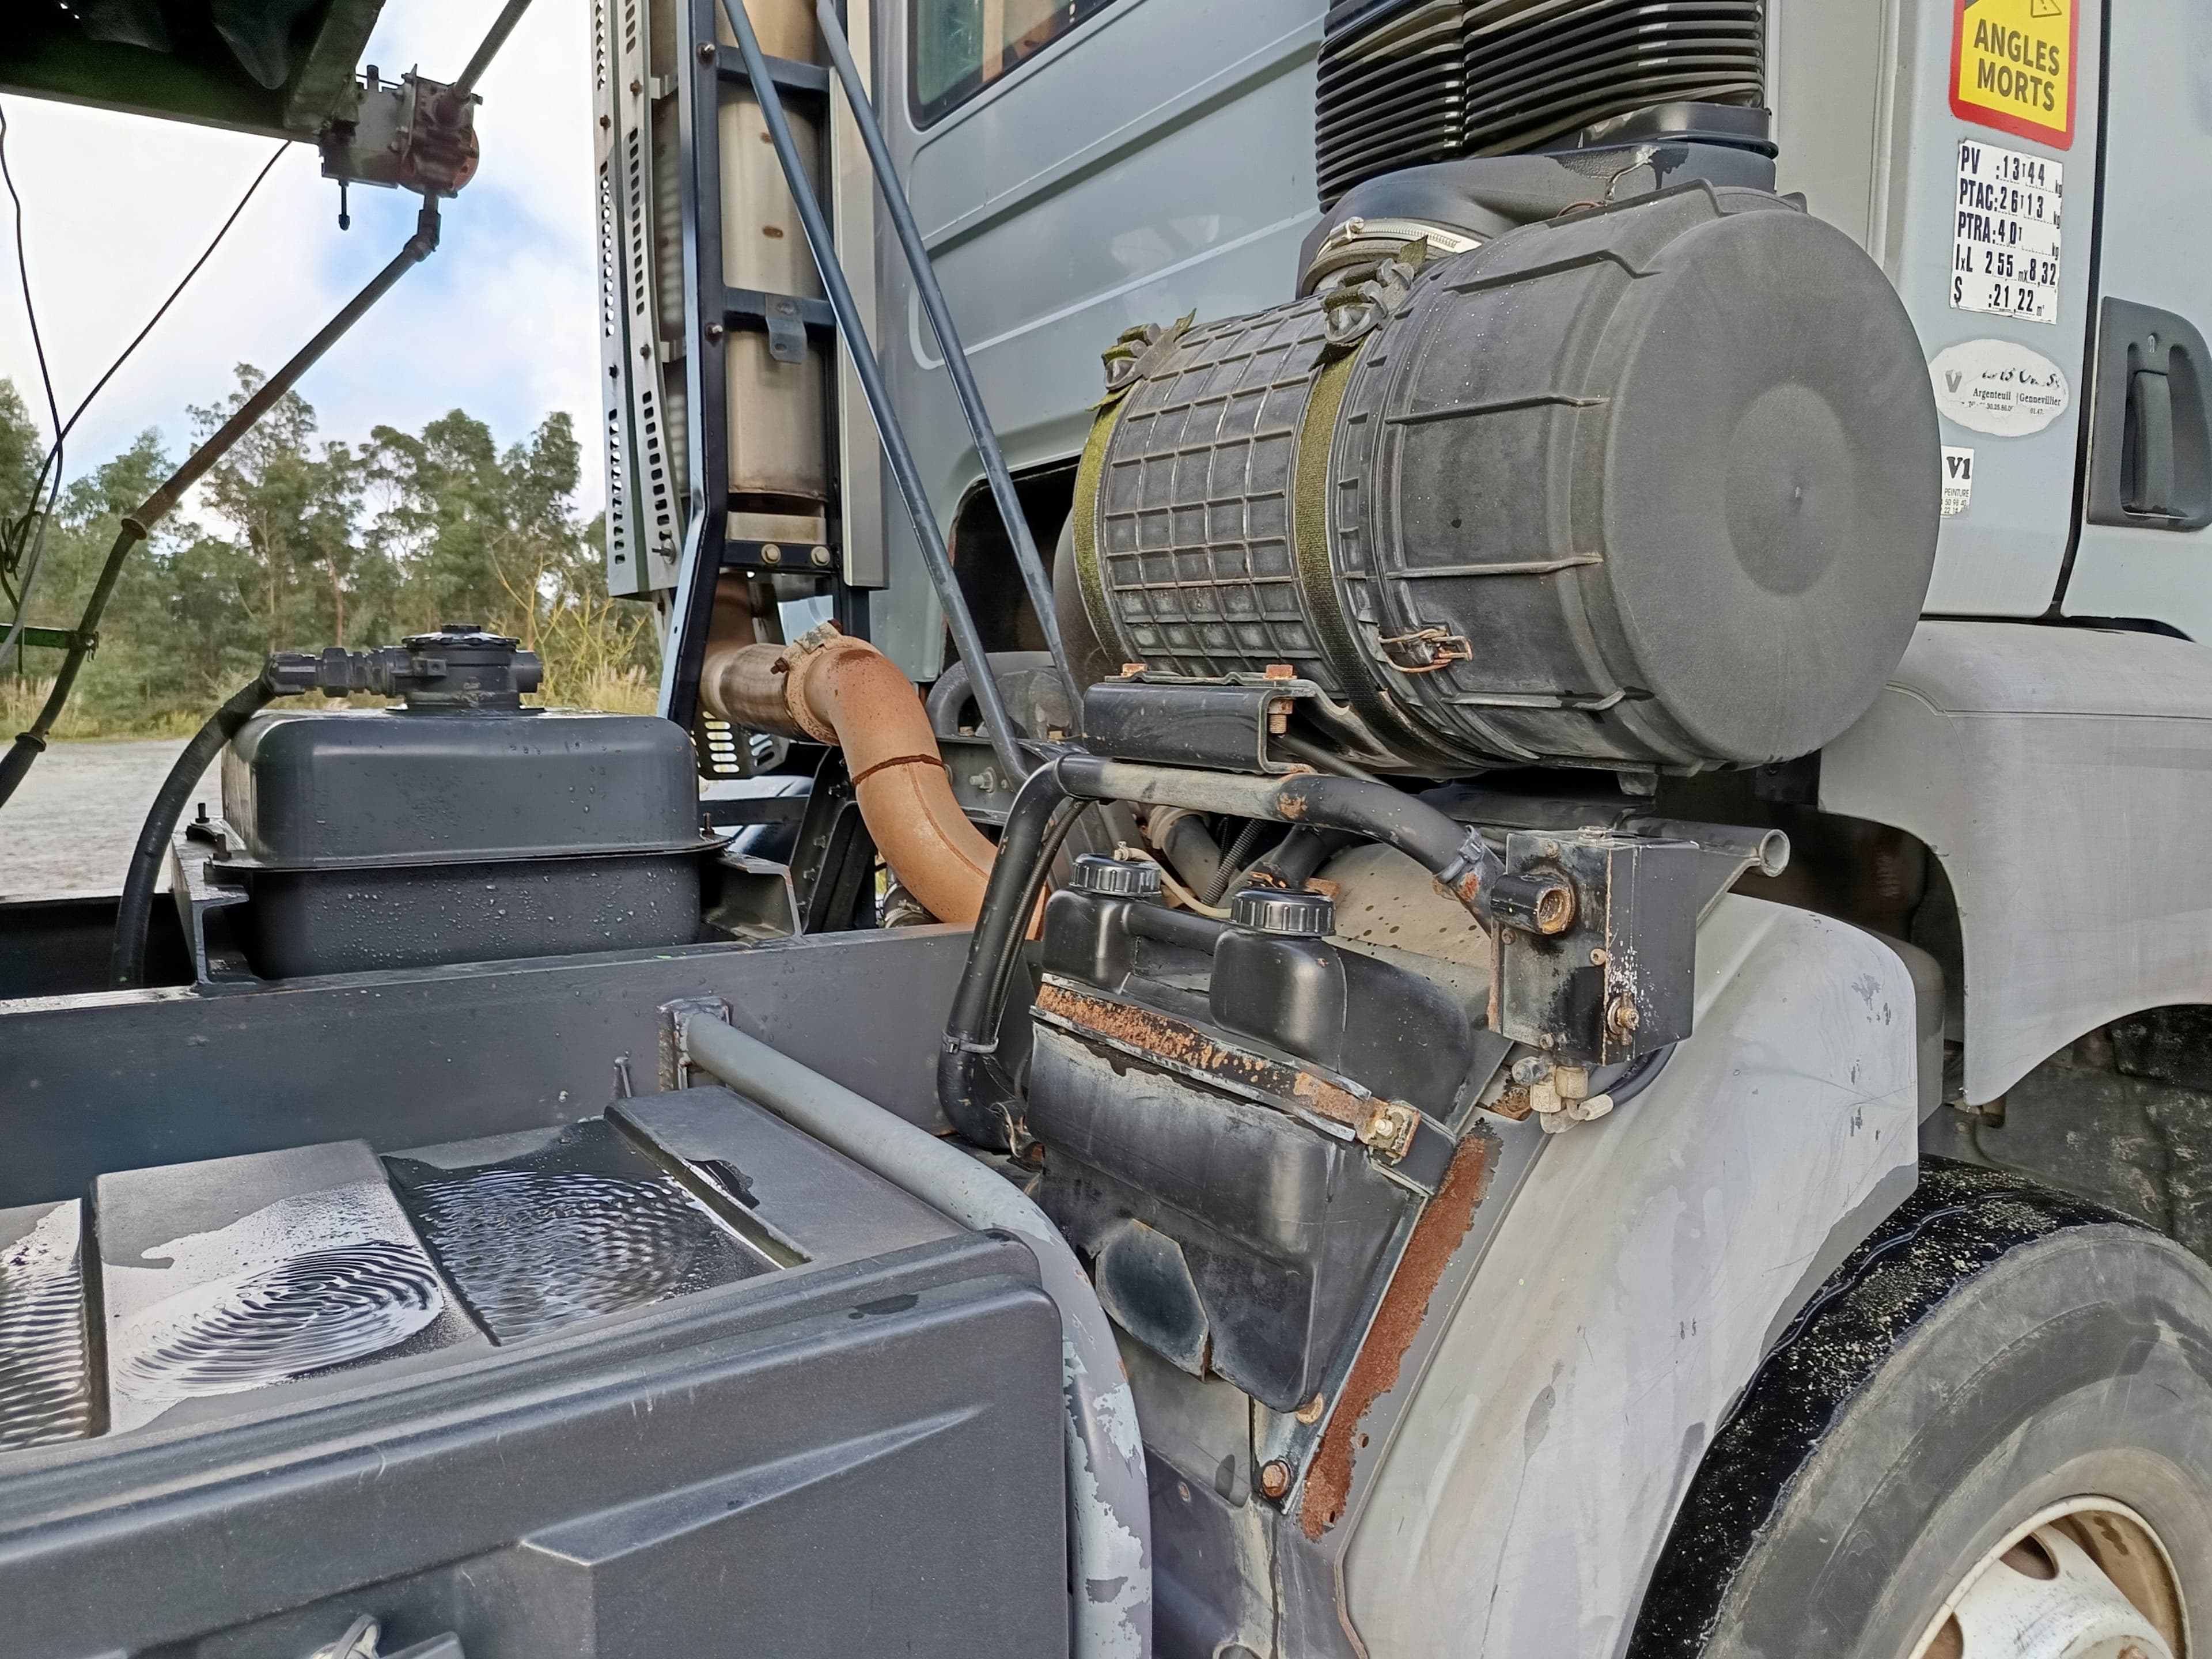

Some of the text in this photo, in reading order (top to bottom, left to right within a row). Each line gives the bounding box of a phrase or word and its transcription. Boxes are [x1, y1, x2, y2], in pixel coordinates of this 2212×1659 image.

[1974, 18, 2060, 76] ANGLES
[1977, 58, 2055, 112] MORTS
[1961, 145, 1980, 175] PV
[1954, 276, 1963, 304] S
[1972, 388, 2012, 400] Argenteuil
[1944, 488, 1969, 498] PEINTURE
